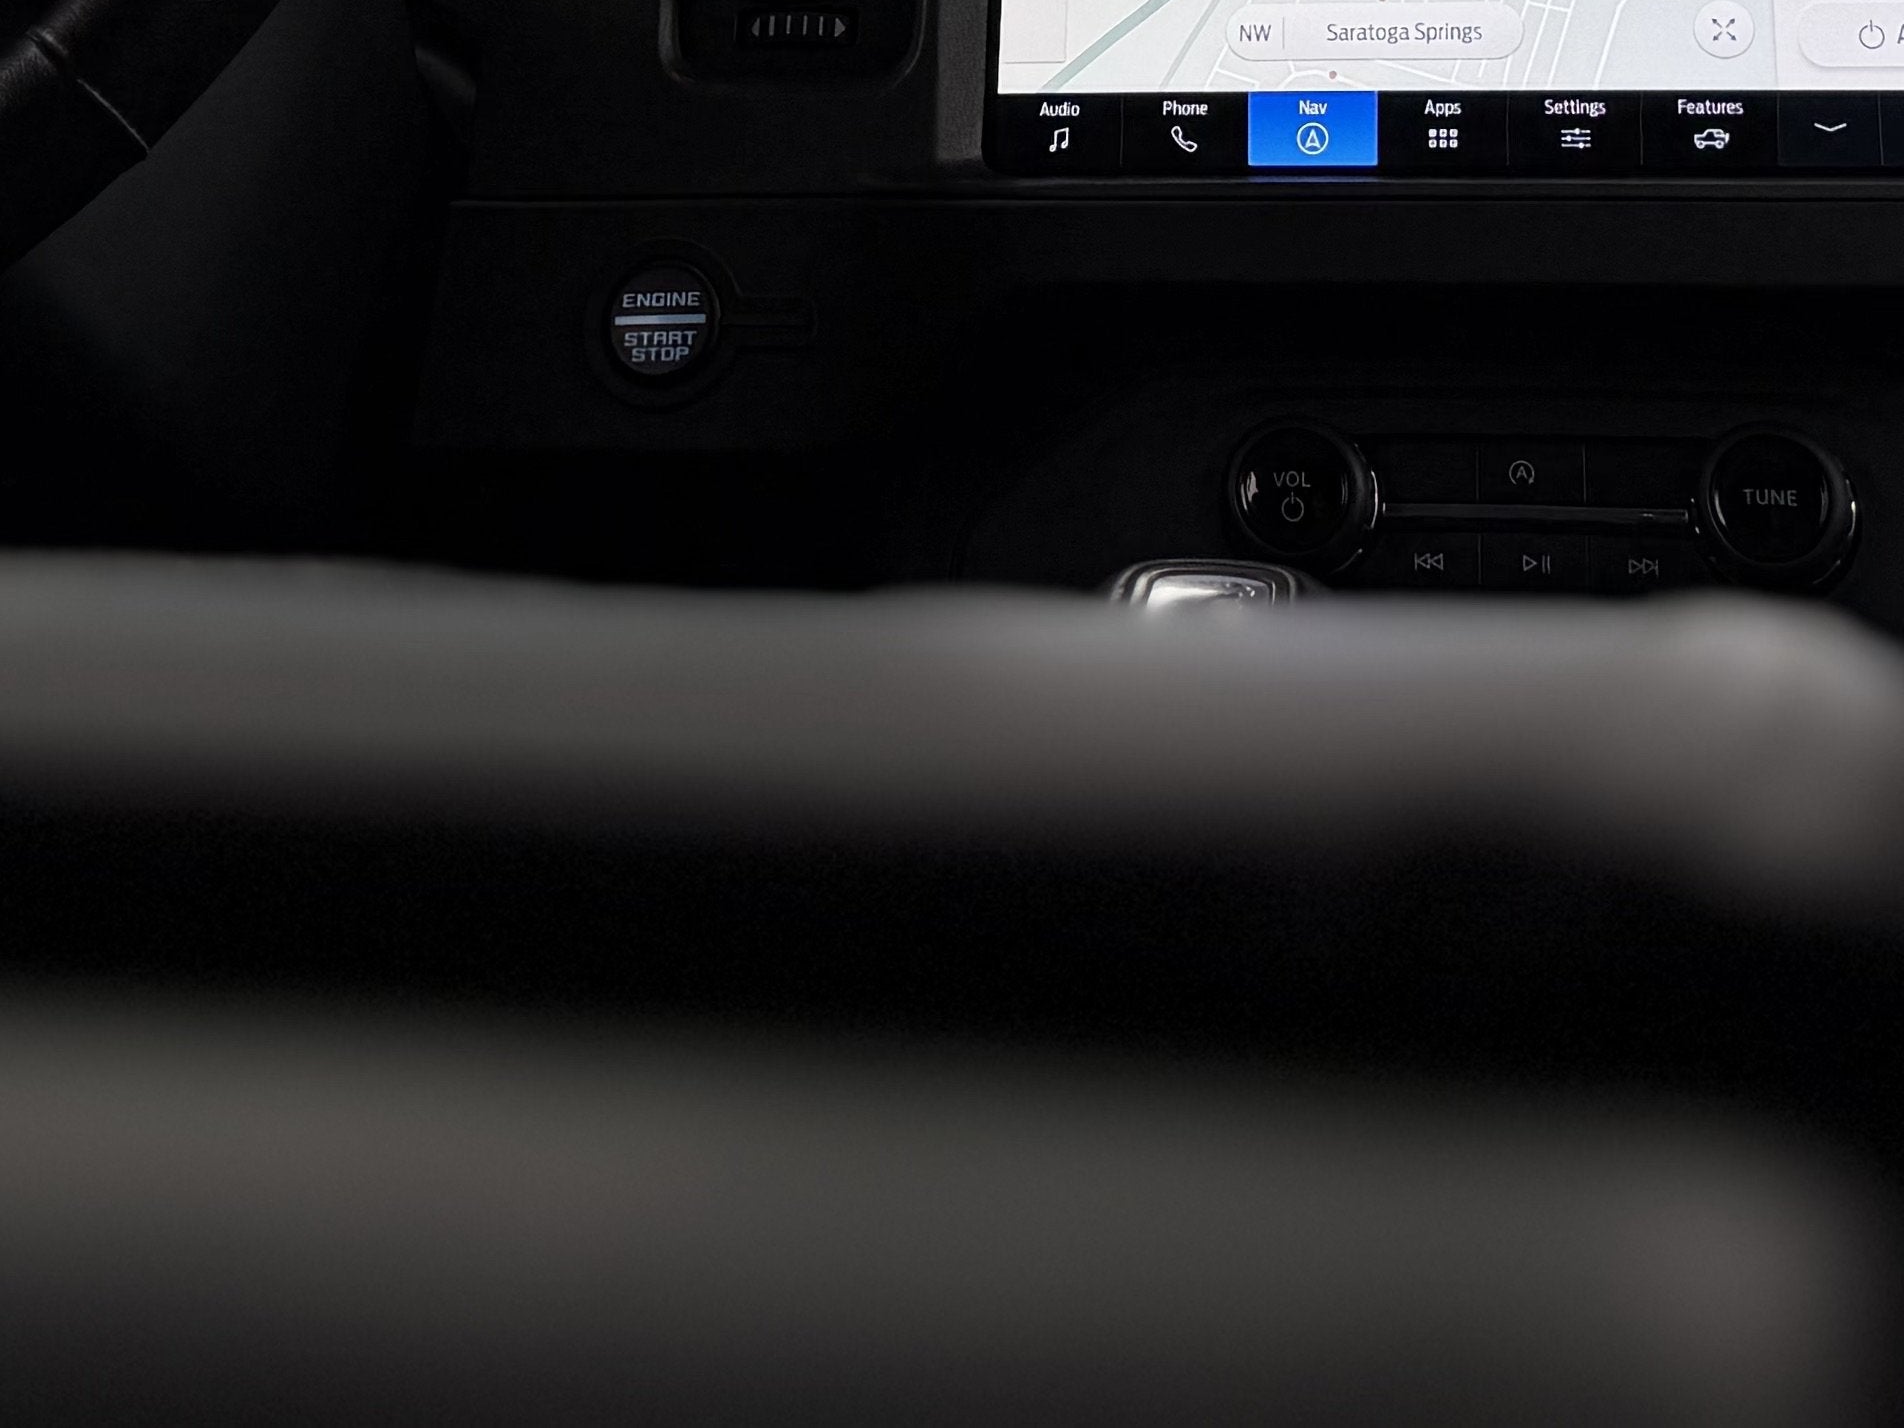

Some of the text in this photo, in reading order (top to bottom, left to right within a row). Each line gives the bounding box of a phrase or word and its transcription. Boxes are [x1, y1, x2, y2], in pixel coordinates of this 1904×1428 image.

[1239, 22, 1483, 44] NW Saratoga Springs
[1039, 99, 1744, 117] Audio Phone Nav Apps Settings Features
[622, 291, 702, 308] ENGINE
[623, 330, 698, 347] START
[631, 346, 690, 362] STOP
[1273, 470, 1311, 488] VOL
[1742, 487, 1799, 508] TUNE
